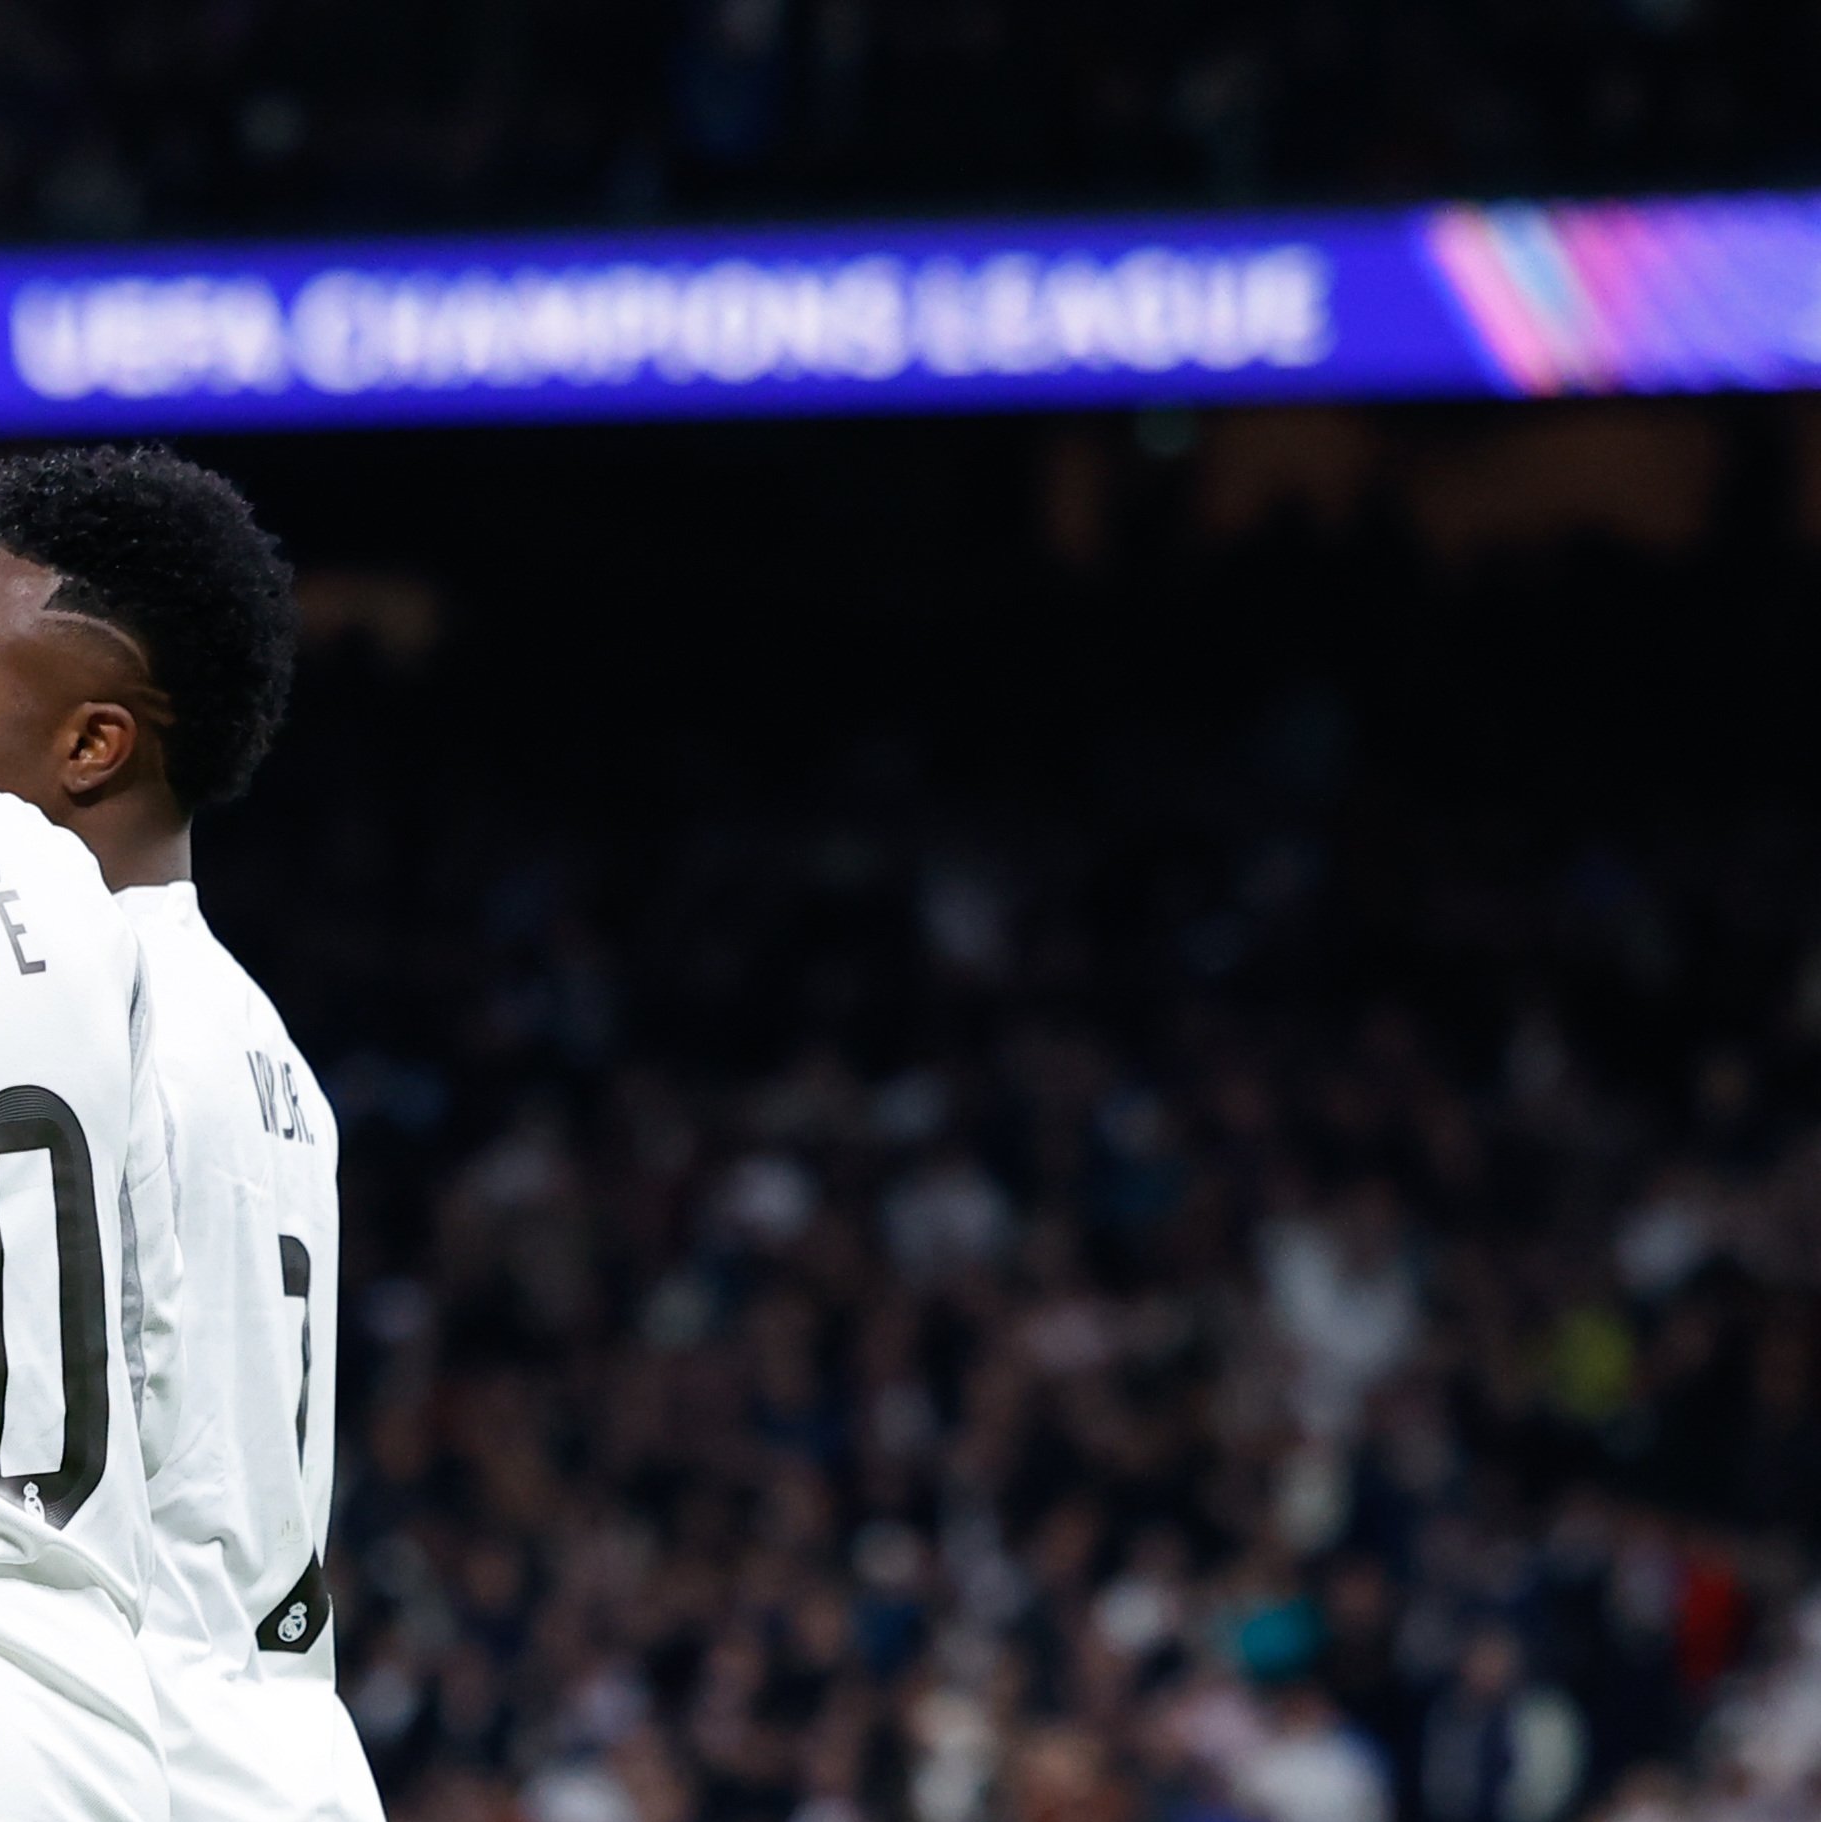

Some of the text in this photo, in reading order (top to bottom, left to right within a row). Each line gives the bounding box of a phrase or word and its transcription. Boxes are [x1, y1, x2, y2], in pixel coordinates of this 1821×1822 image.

[13, 248, 1329, 397] UEFA CHAMPIONS LEAGUE
